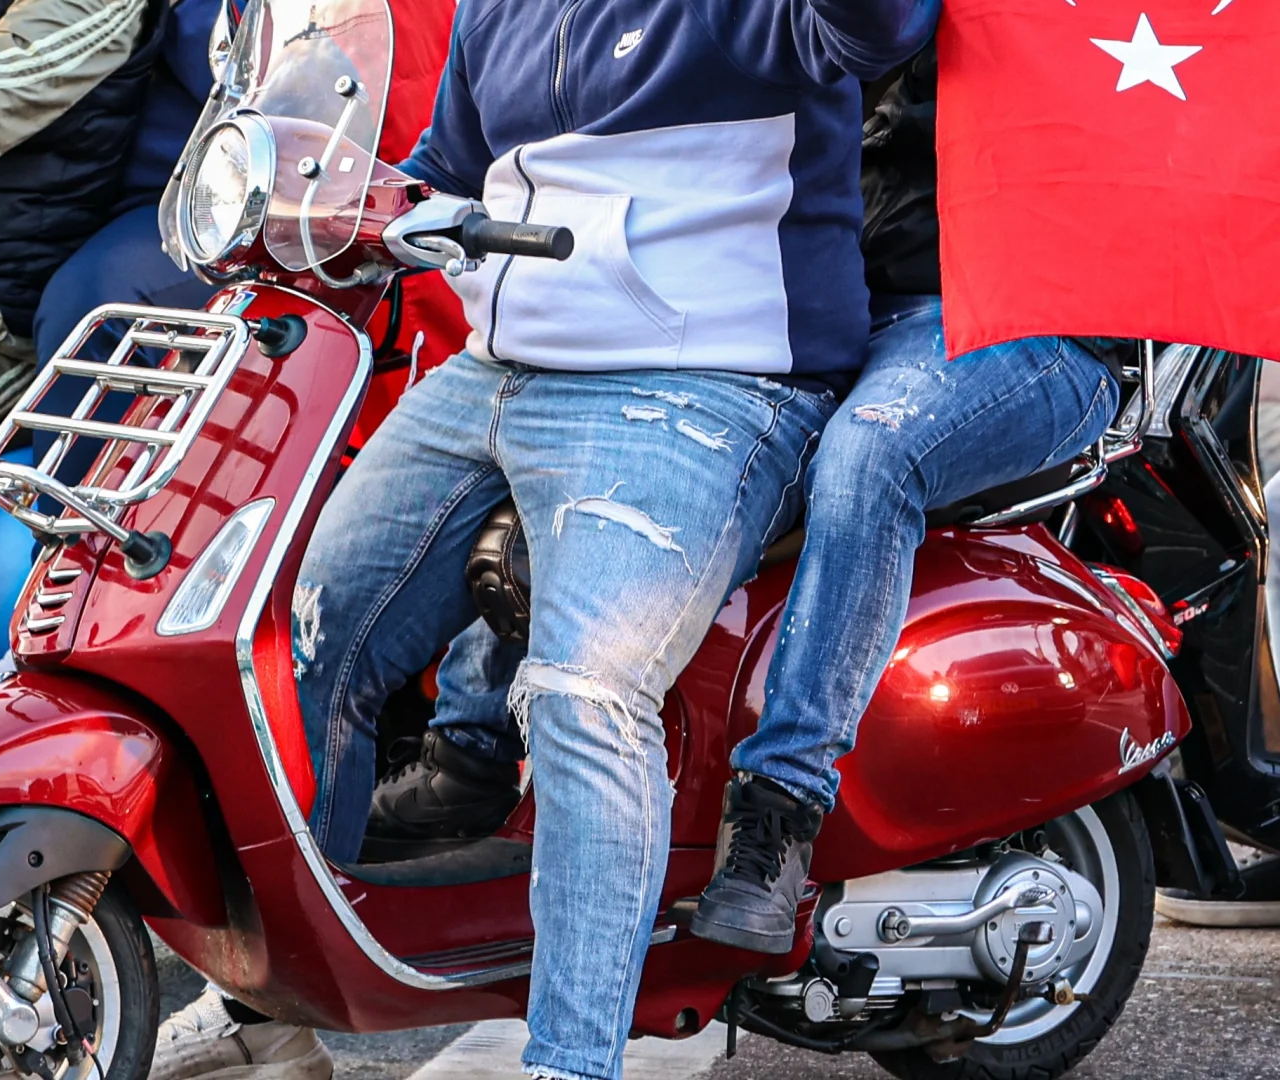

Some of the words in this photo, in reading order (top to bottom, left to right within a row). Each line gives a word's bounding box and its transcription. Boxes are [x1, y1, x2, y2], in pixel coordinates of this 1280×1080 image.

[620, 29, 642, 48] NIKE
[1118, 727, 1176, 775] Vespa
[1002, 1008, 1094, 1060] MICHELIN
